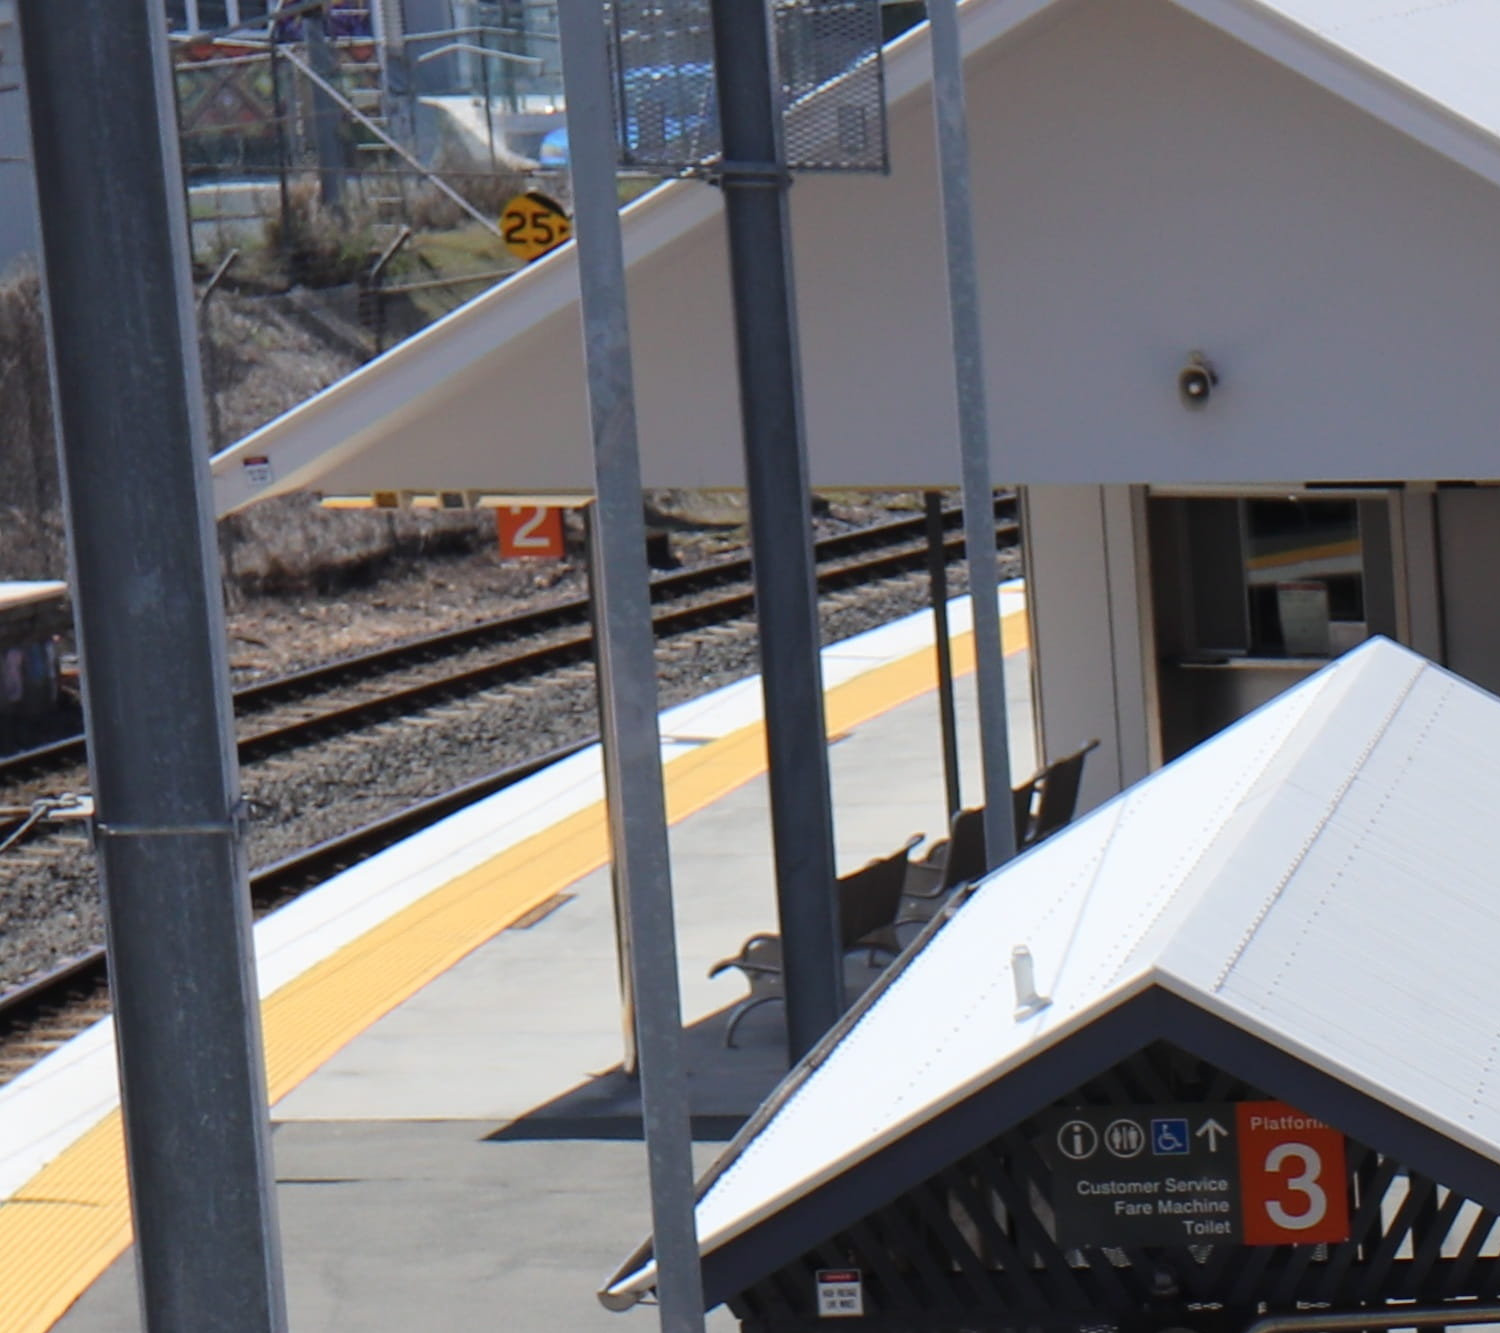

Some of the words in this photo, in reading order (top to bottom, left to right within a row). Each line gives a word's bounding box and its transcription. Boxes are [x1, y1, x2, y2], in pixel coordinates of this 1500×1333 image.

[506, 211, 554, 245] 25
[510, 505, 550, 547] 2
[1076, 1179, 1160, 1196] Customer
[1165, 1177, 1228, 1193] Service
[1264, 1142, 1328, 1230] 3
[1114, 1201, 1152, 1216] Fare
[1157, 1198, 1230, 1214] Machine
[1184, 1219, 1232, 1234] Toilet
